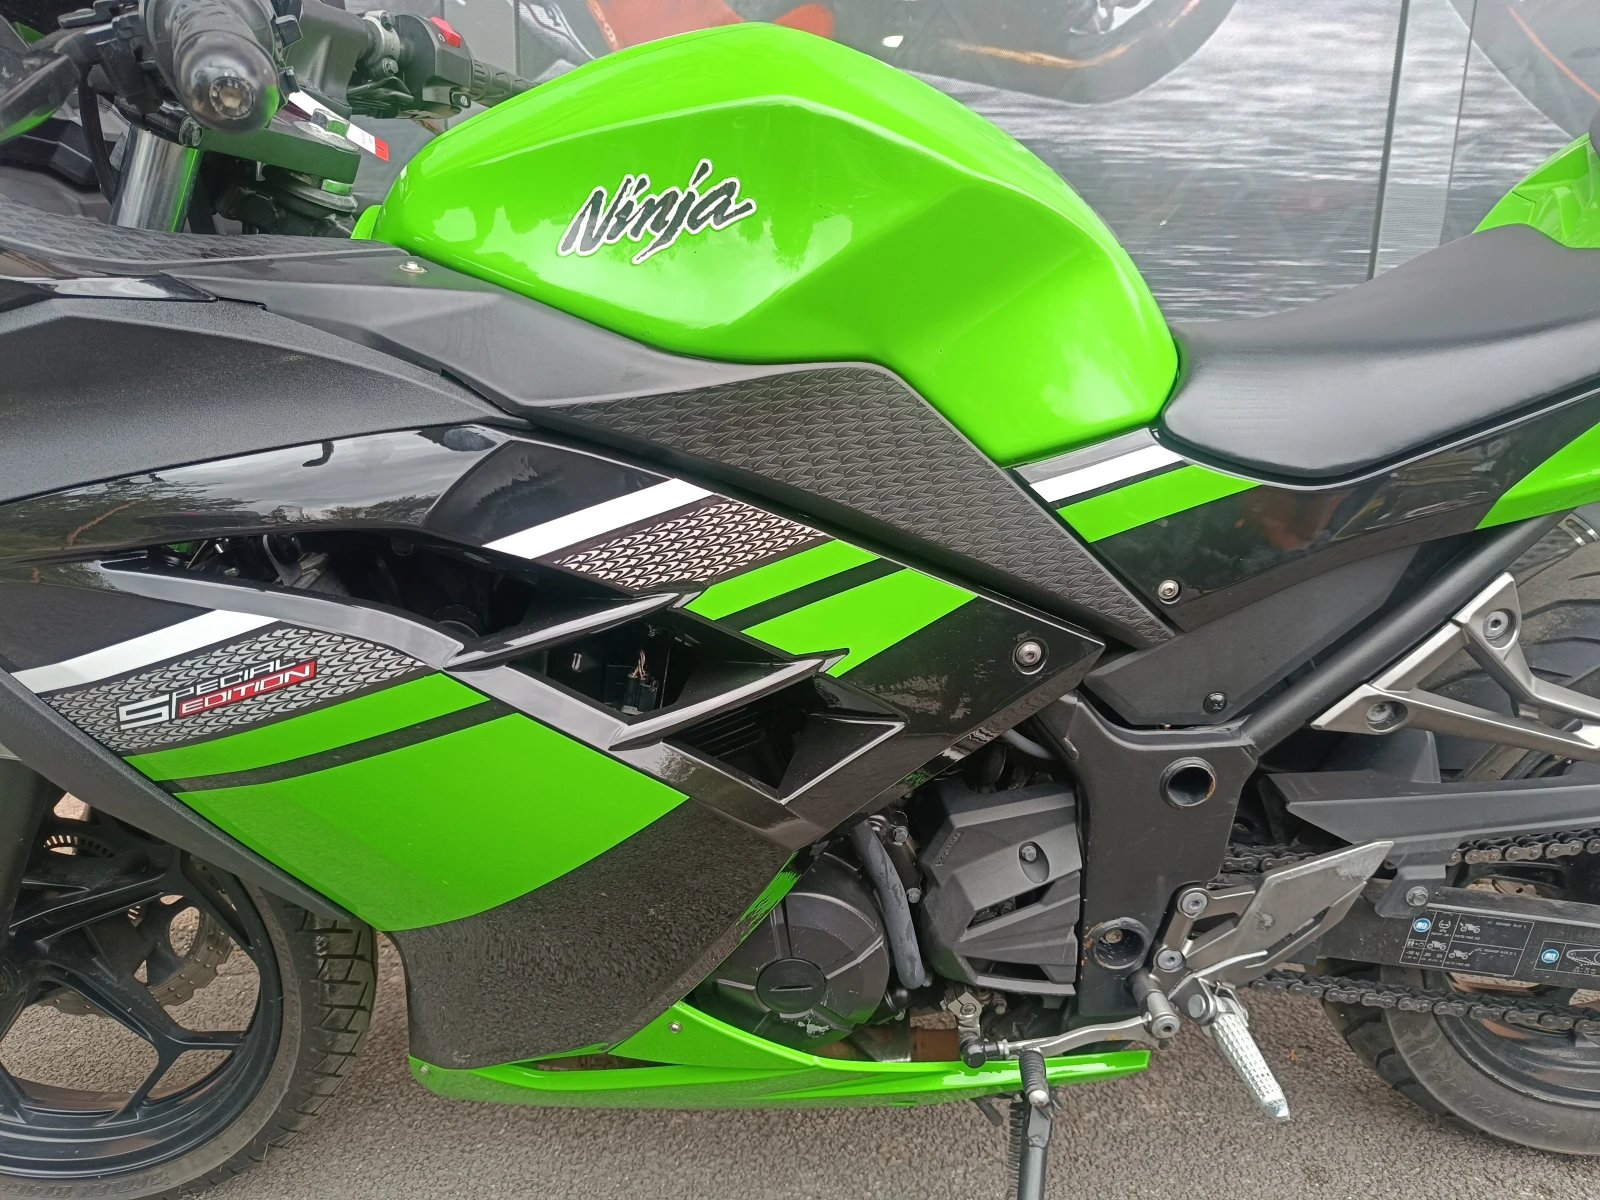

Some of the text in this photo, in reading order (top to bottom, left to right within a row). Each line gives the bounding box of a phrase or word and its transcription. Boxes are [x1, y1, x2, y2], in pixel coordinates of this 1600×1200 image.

[557, 160, 756, 263] Ninja
[118, 658, 297, 731] SPECIAL
[181, 664, 311, 715] EDITION
